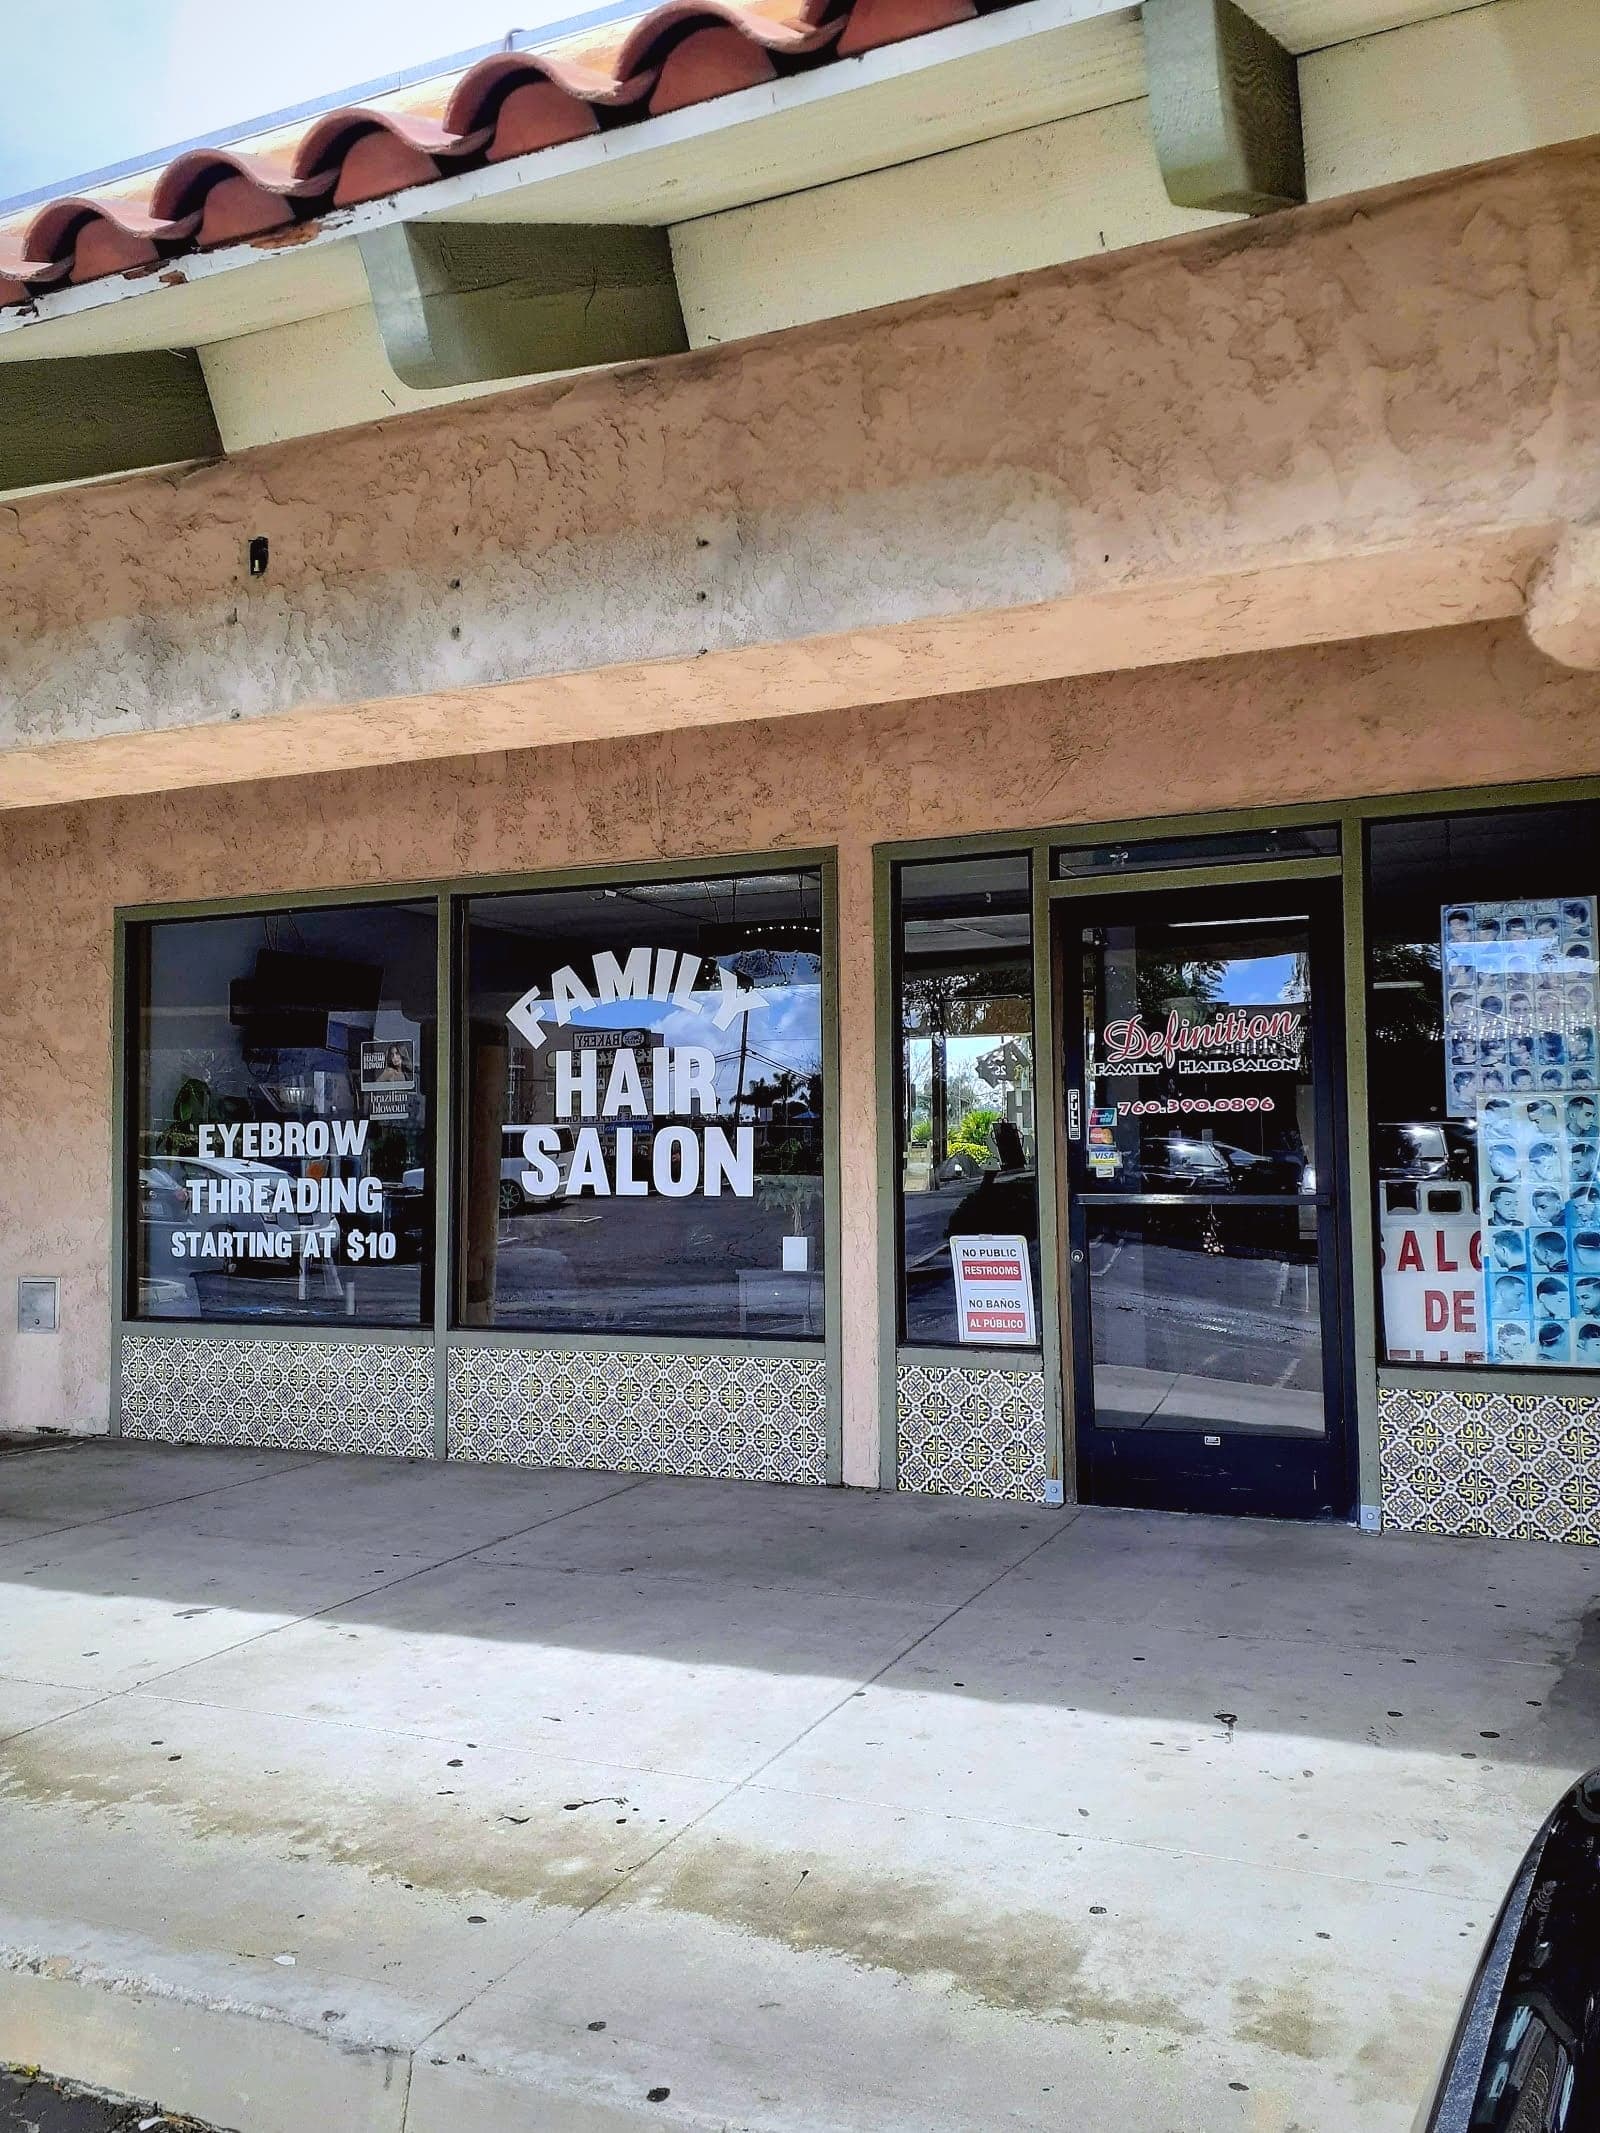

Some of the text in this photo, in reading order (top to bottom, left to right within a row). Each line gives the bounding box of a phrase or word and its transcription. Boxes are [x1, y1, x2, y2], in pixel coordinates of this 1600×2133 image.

[505, 947, 770, 1050] FAMILY
[1103, 1009, 1300, 1069] Definition
[1094, 1057, 1300, 1076] FAMILY HAIR SALON
[555, 1046, 718, 1118] HAIR
[372, 1102, 407, 1113] blowout
[1117, 1097, 1275, 1116] 760.390.0896
[198, 1119, 368, 1158] EYEBROW
[521, 1125, 754, 1197] SALON
[1095, 1151, 1115, 1159] VISA
[186, 1177, 382, 1214] THREADING
[171, 1228, 396, 1262] STARTING AT $10
[962, 1249, 1017, 1257] NO PUBLIC
[964, 1266, 1019, 1275] RESTROOMS
[969, 1296, 1021, 1308] NO BAÑOS
[1425, 1290, 1476, 1332] DE
[970, 1317, 1024, 1328] AL PÚBLICO
